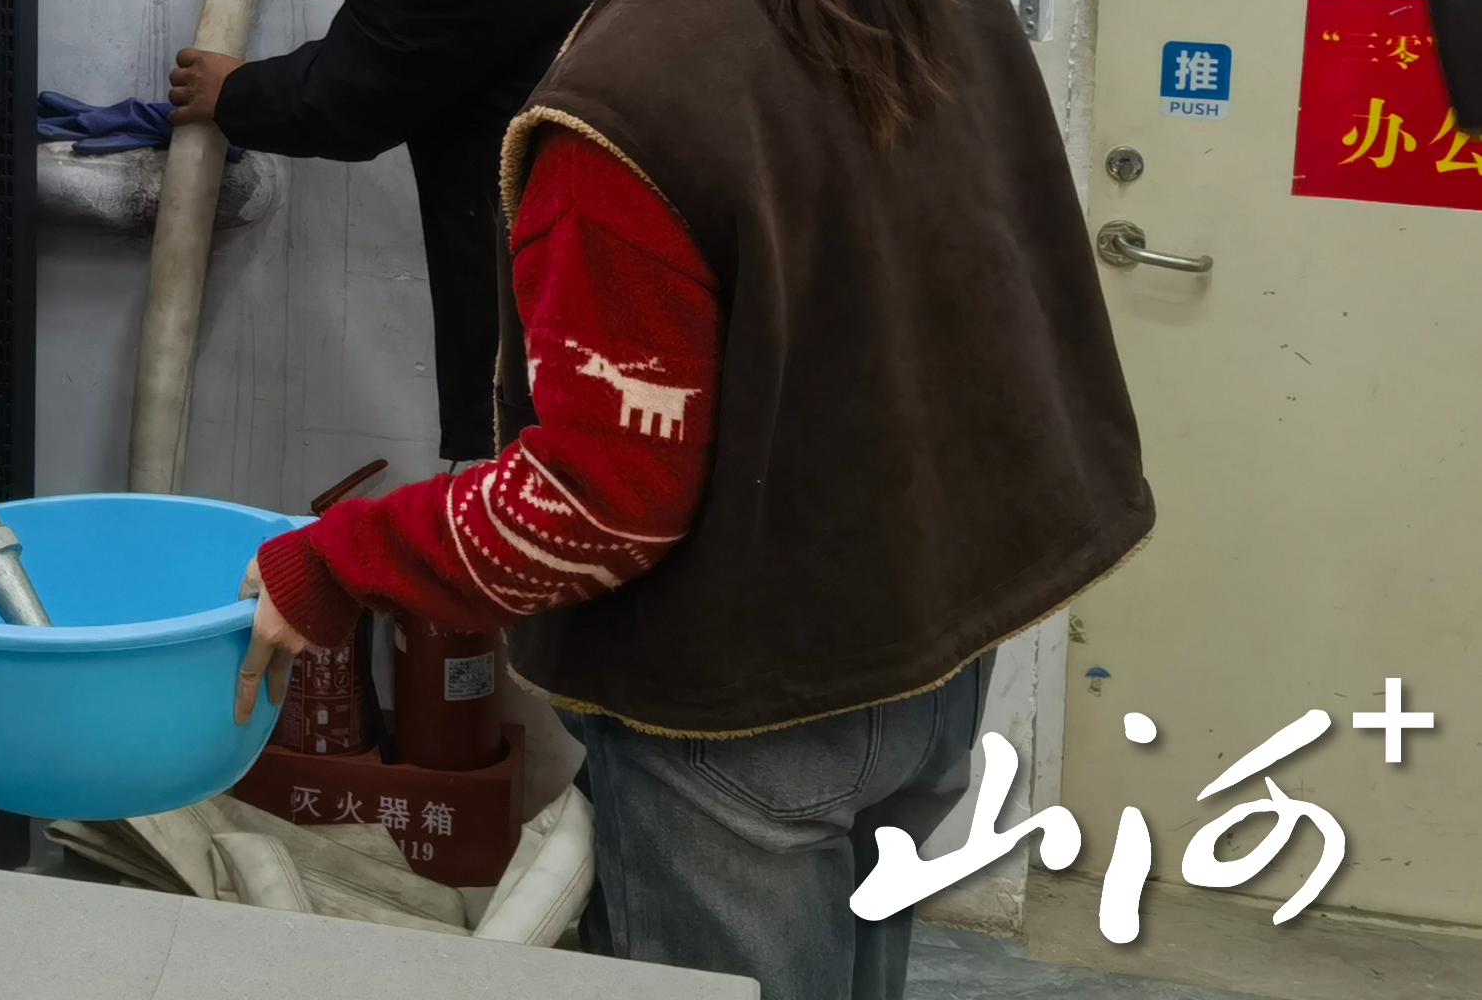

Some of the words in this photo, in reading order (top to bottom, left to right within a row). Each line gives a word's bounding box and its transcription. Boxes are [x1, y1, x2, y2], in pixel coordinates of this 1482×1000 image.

[1175, 50, 1220, 91] 推
[1169, 101, 1220, 117] PUSH
[290, 785, 456, 837] 灭火器箱
